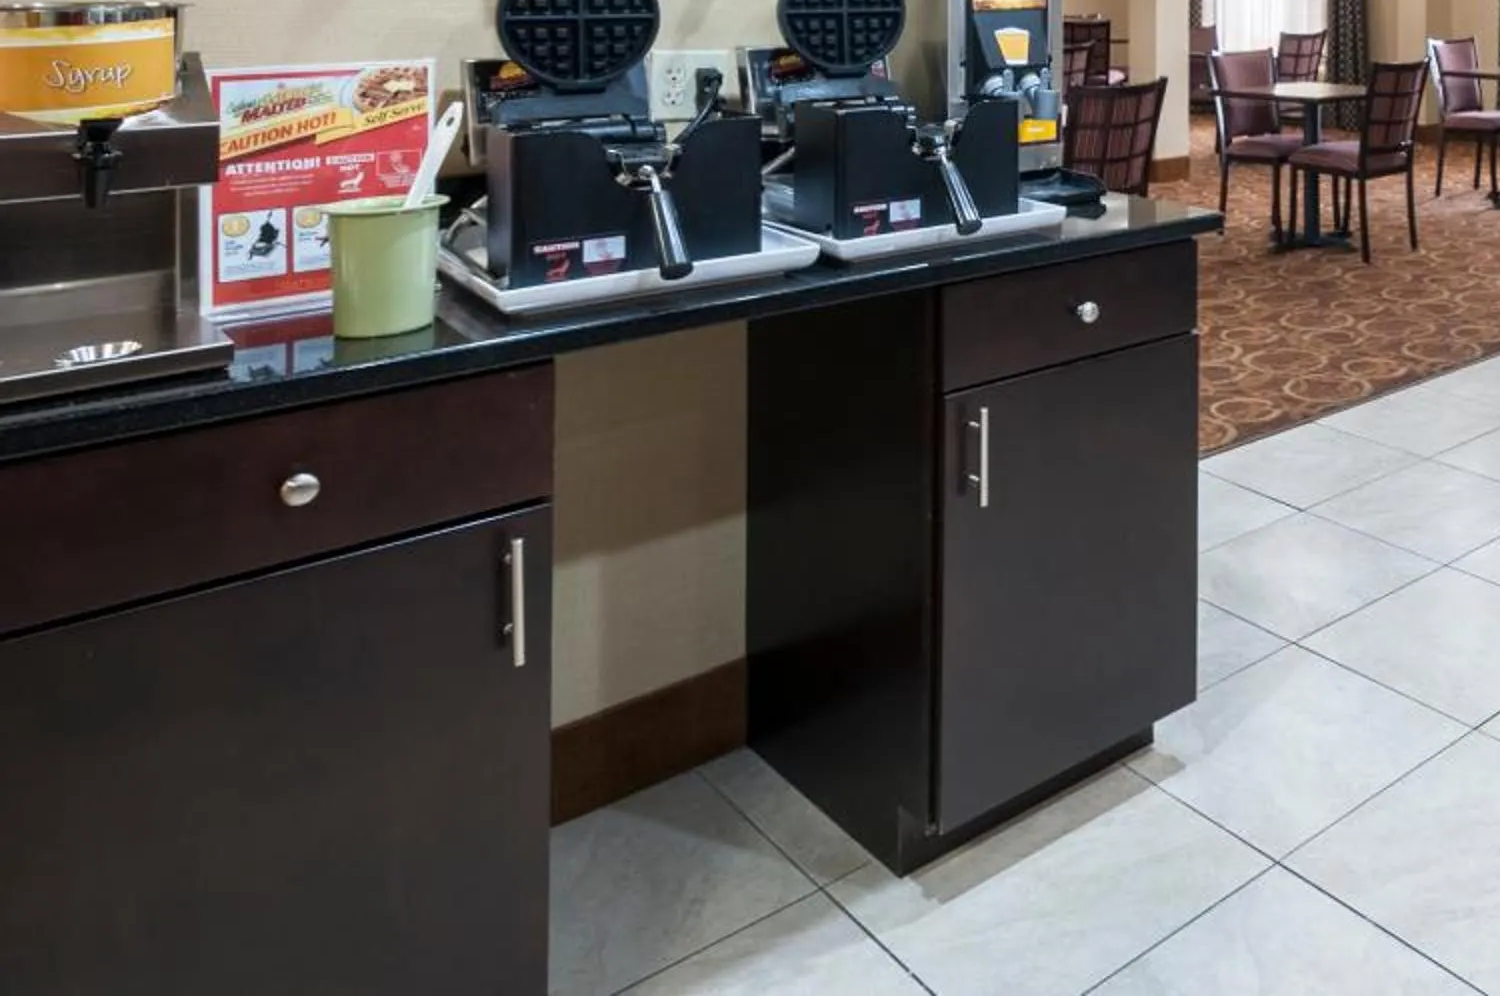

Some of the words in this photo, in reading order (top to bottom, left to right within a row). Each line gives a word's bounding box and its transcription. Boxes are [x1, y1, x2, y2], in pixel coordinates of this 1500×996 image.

[45, 59, 131, 94] Syrup
[297, 110, 337, 132] HOT!
[225, 156, 320, 176] ATTENTION!
